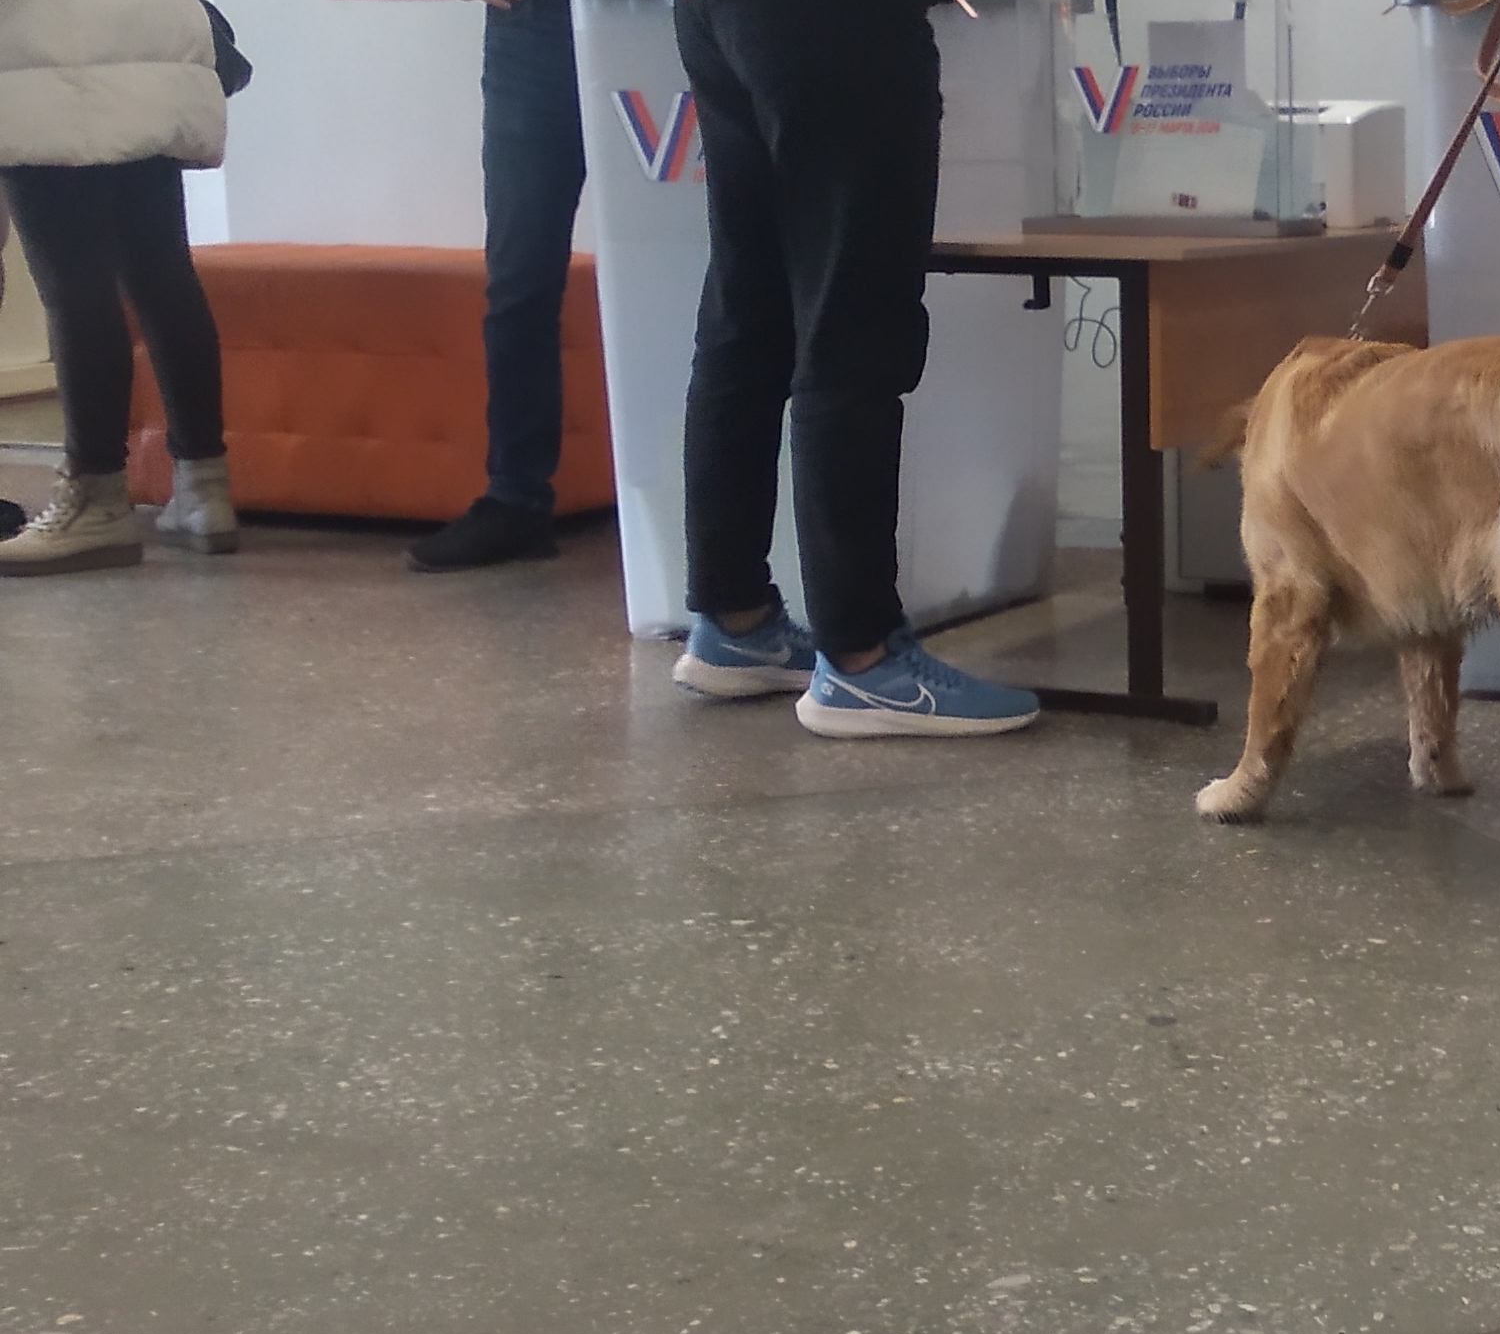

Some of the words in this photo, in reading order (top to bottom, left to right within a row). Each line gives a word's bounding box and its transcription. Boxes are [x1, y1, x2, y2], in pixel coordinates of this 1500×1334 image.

[1147, 64, 1212, 80] ВЫБОРЫ
[1140, 82, 1233, 99] ПРЕЗИДЕНТА
[1133, 102, 1193, 118] РОССИИ
